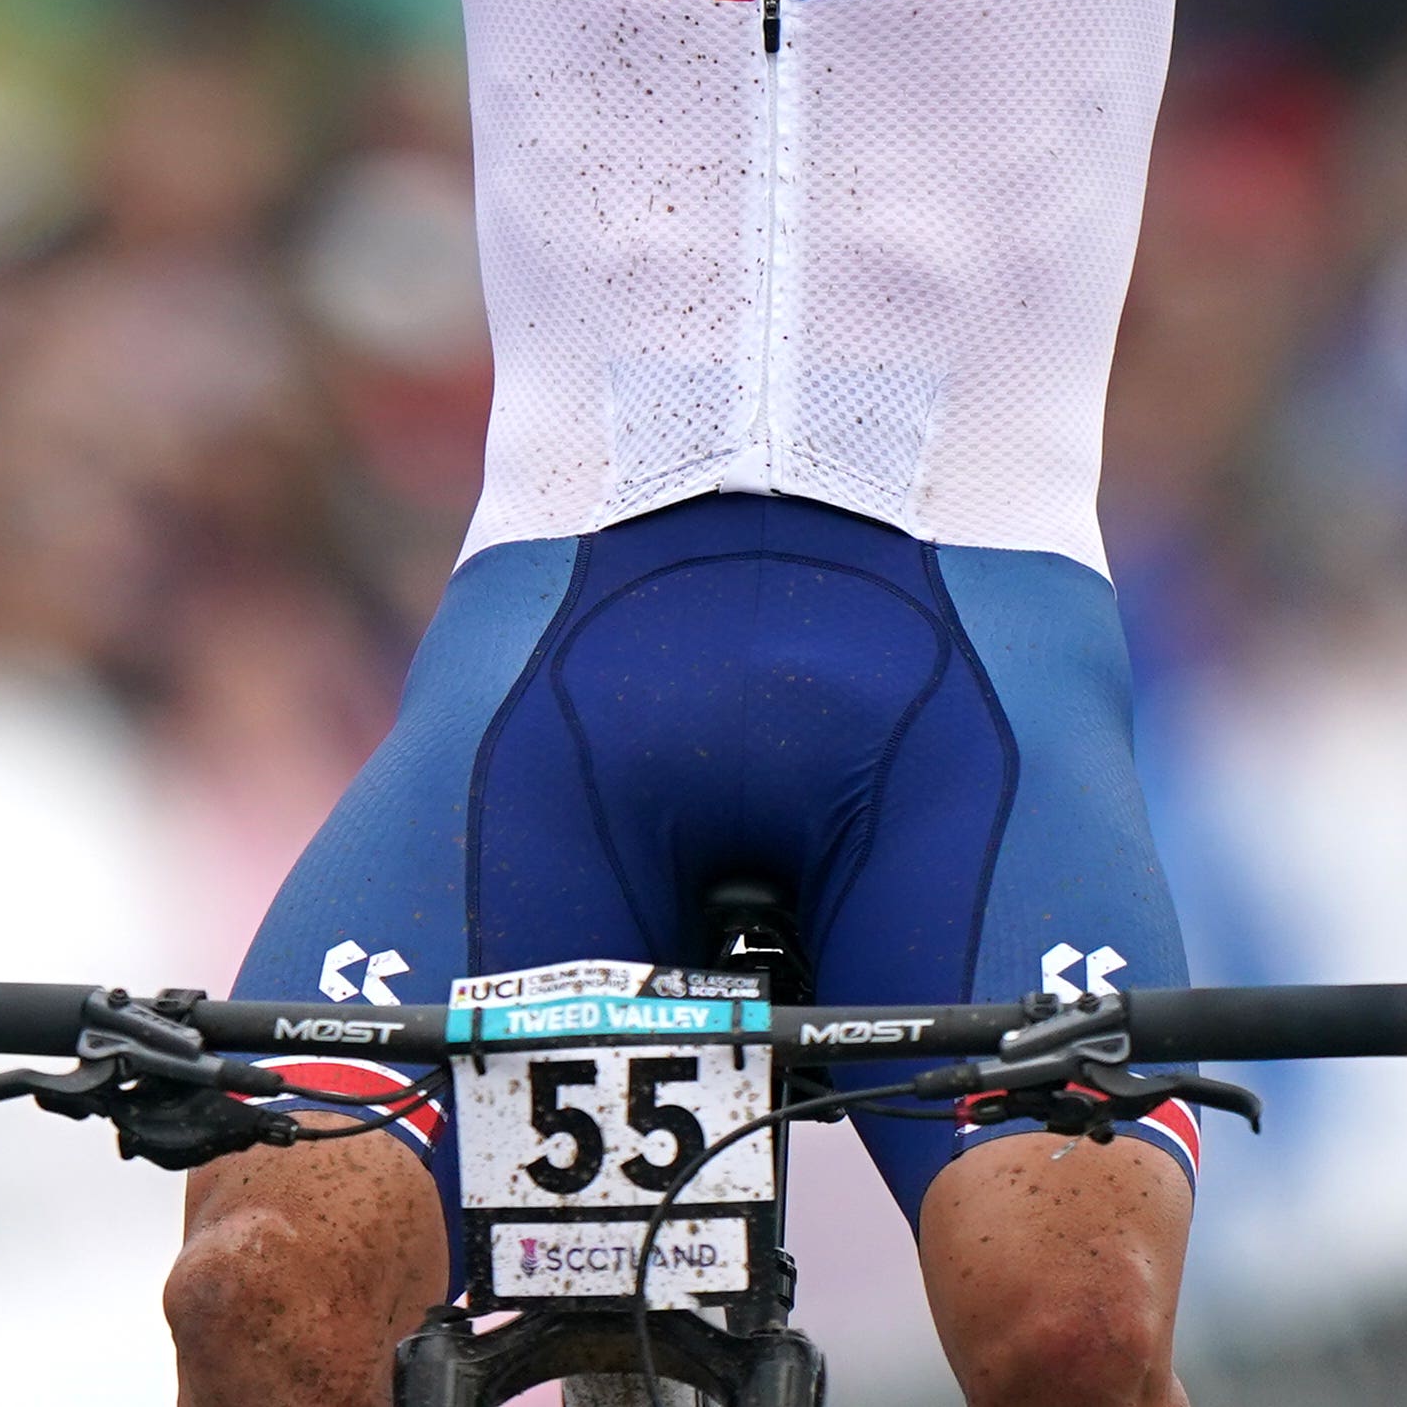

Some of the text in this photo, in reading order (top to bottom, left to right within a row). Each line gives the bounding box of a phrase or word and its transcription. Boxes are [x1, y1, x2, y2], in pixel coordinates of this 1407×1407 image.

[471, 977, 523, 1001] UCI
[505, 1002, 710, 1034] TWEED VALLEY
[525, 1056, 706, 1195] 55
